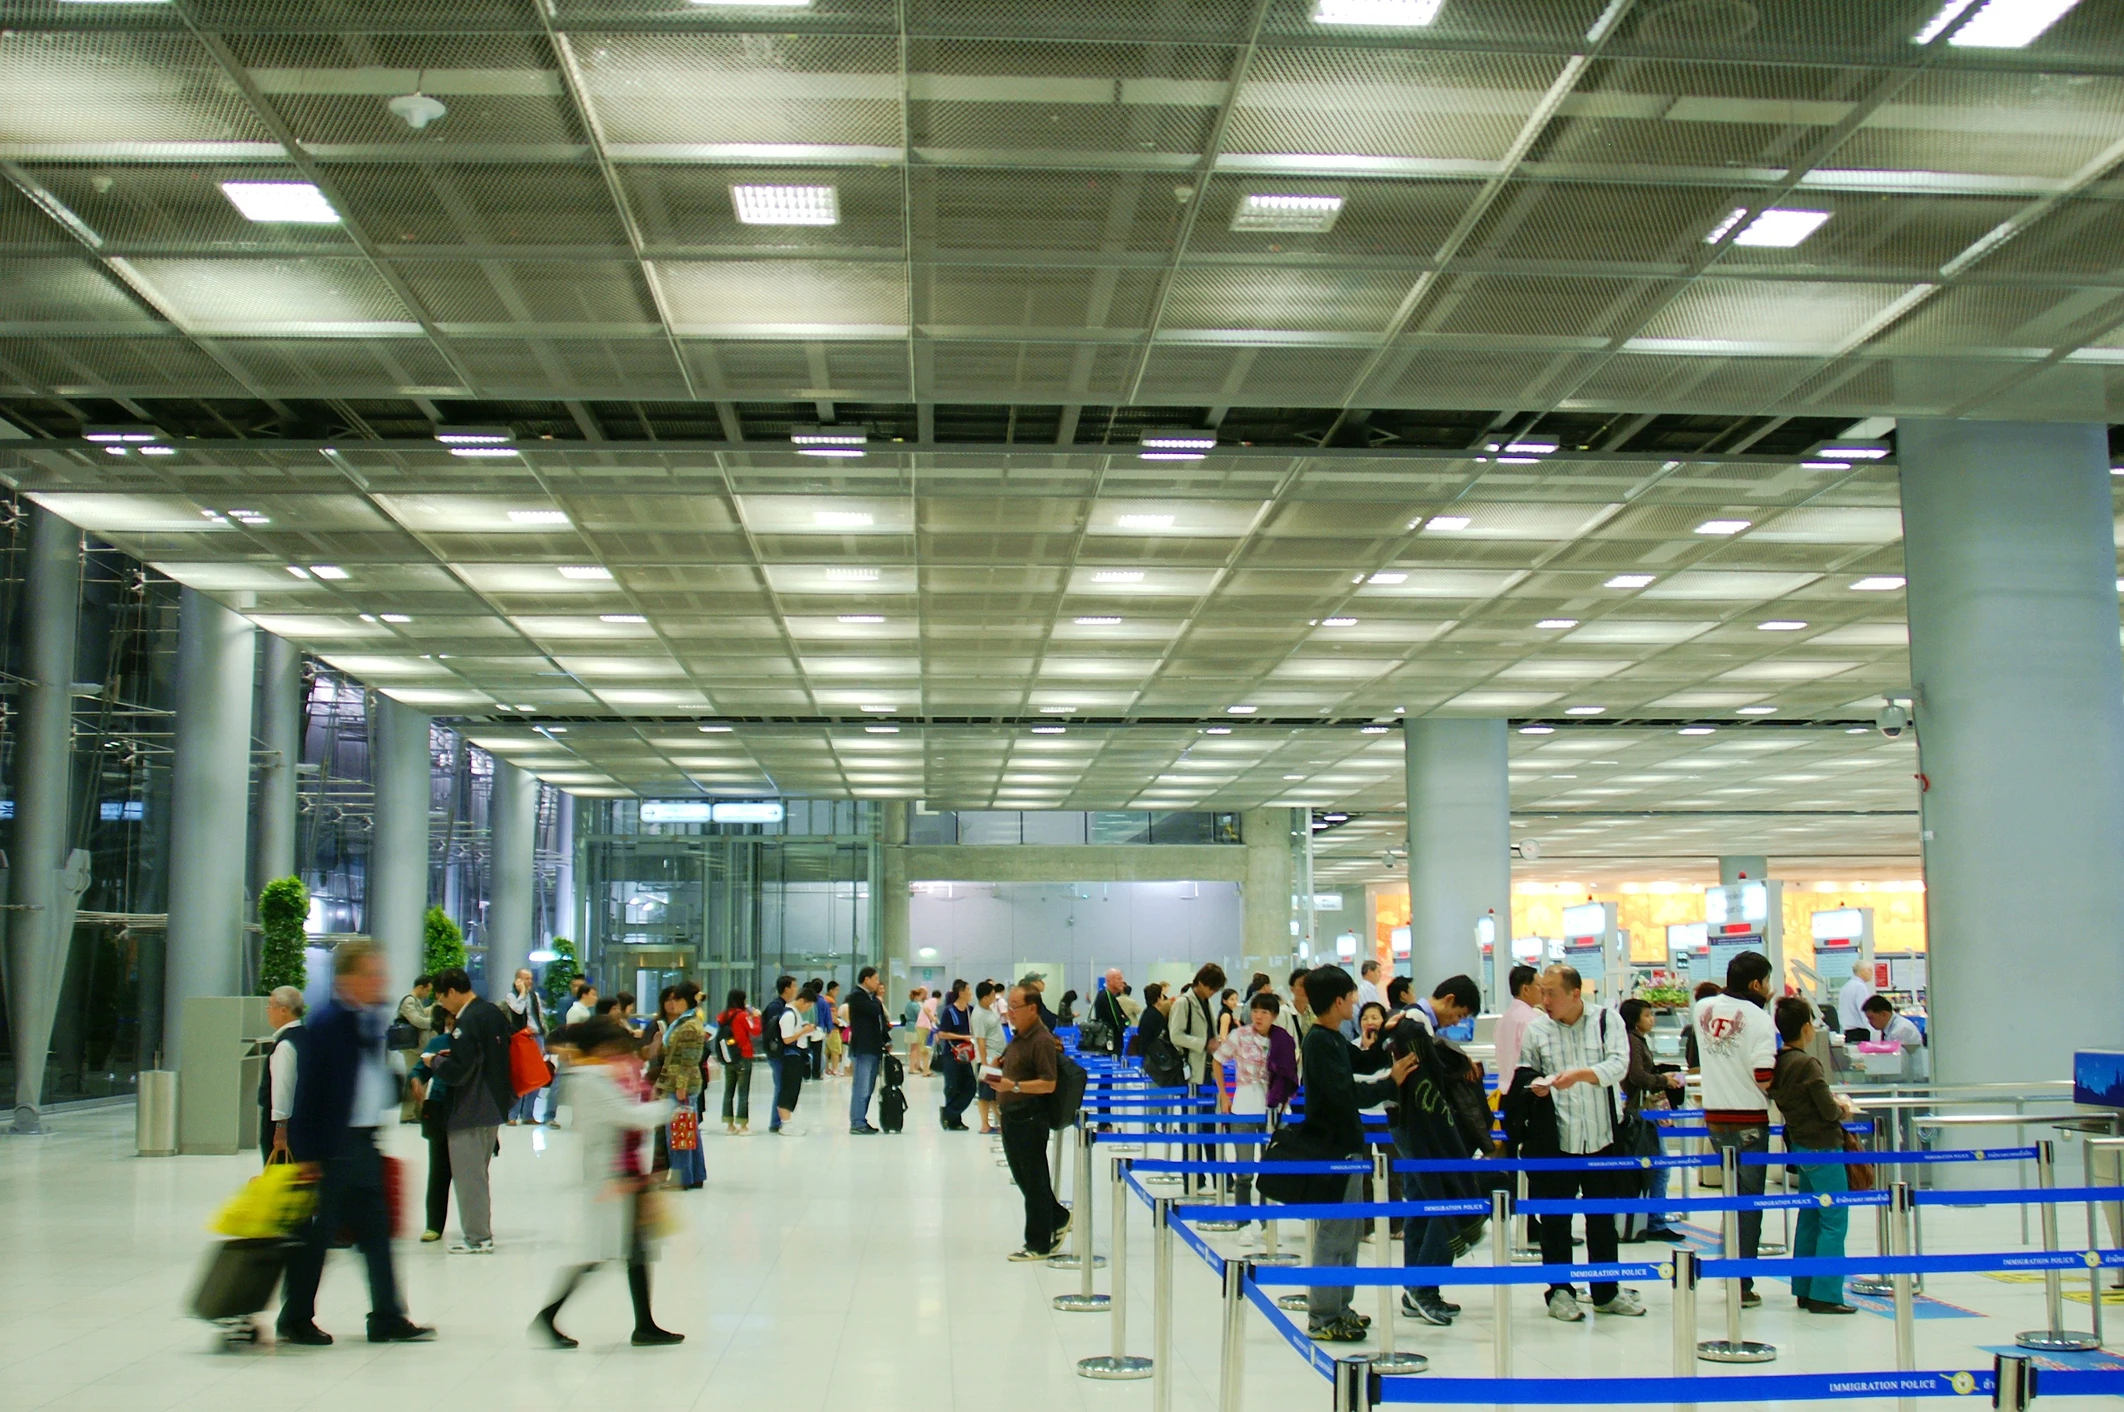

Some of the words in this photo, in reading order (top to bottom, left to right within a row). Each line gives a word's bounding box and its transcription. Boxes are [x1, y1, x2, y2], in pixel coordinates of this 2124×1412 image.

[1423, 1204, 1462, 1212] IMMIGRATION
[2003, 1257, 2049, 1265] IMMIGRATION
[2050, 1256, 2074, 1264] POLICE
[1570, 1269, 1619, 1278] IMMIGRATION
[1621, 1268, 1647, 1277] POLICE
[1829, 1380, 1898, 1393] IMMIGRATION
[1900, 1379, 1936, 1390] POLICE
